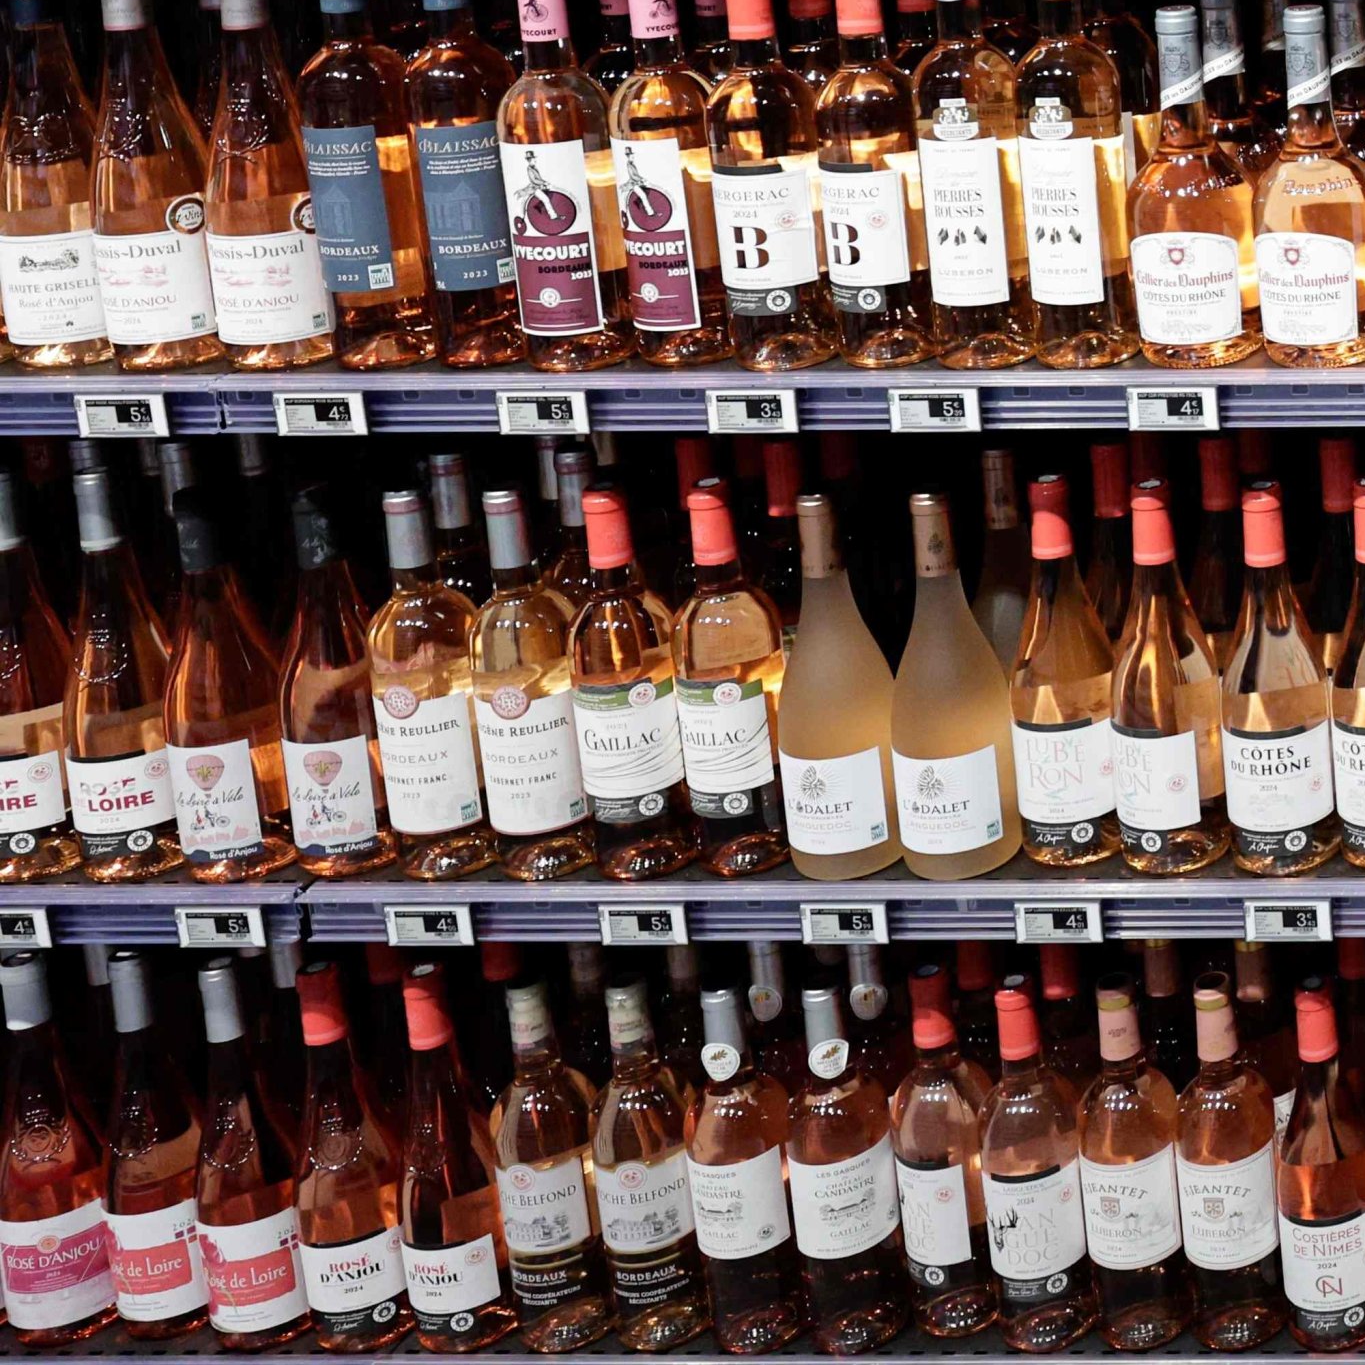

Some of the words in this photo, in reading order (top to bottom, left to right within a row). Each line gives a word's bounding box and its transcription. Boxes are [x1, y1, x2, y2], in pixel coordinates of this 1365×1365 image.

[304, 140, 372, 156] BLAISSAC
[934, 188, 983, 204] PIERRES
[733, 209, 758, 218] 2024
[934, 204, 985, 218] ROUSSES
[319, 244, 379, 256] BORDEAUX
[337, 273, 359, 282] 2023
[538, 263, 592, 275] BORDEAUX
[1178, 267, 1235, 289] Dauphins
[1143, 288, 1171, 302] CÔTES
[1171, 291, 1184, 300] DU
[1187, 287, 1227, 301] RHÔNE
[584, 729, 662, 752] GAILLAC
[1240, 744, 1294, 762] CÔTES
[1231, 761, 1247, 773] DU
[1251, 755, 1312, 775] RHÔNE
[88, 791, 155, 813] LOIRE
[209, 849, 229, 860] Rosé
[229, 846, 258, 859] d'Anjou
[520, 1182, 578, 1205] BELFOND
[7, 1253, 41, 1270] ROSÉ
[43, 1237, 100, 1266] D'ANJOU
[1294, 1244, 1309, 1257] DE
[126, 1264, 140, 1277] de
[144, 1257, 182, 1274] Loire
[328, 1254, 371, 1273] ROSÉ
[615, 1265, 676, 1283] BORDEAUX
